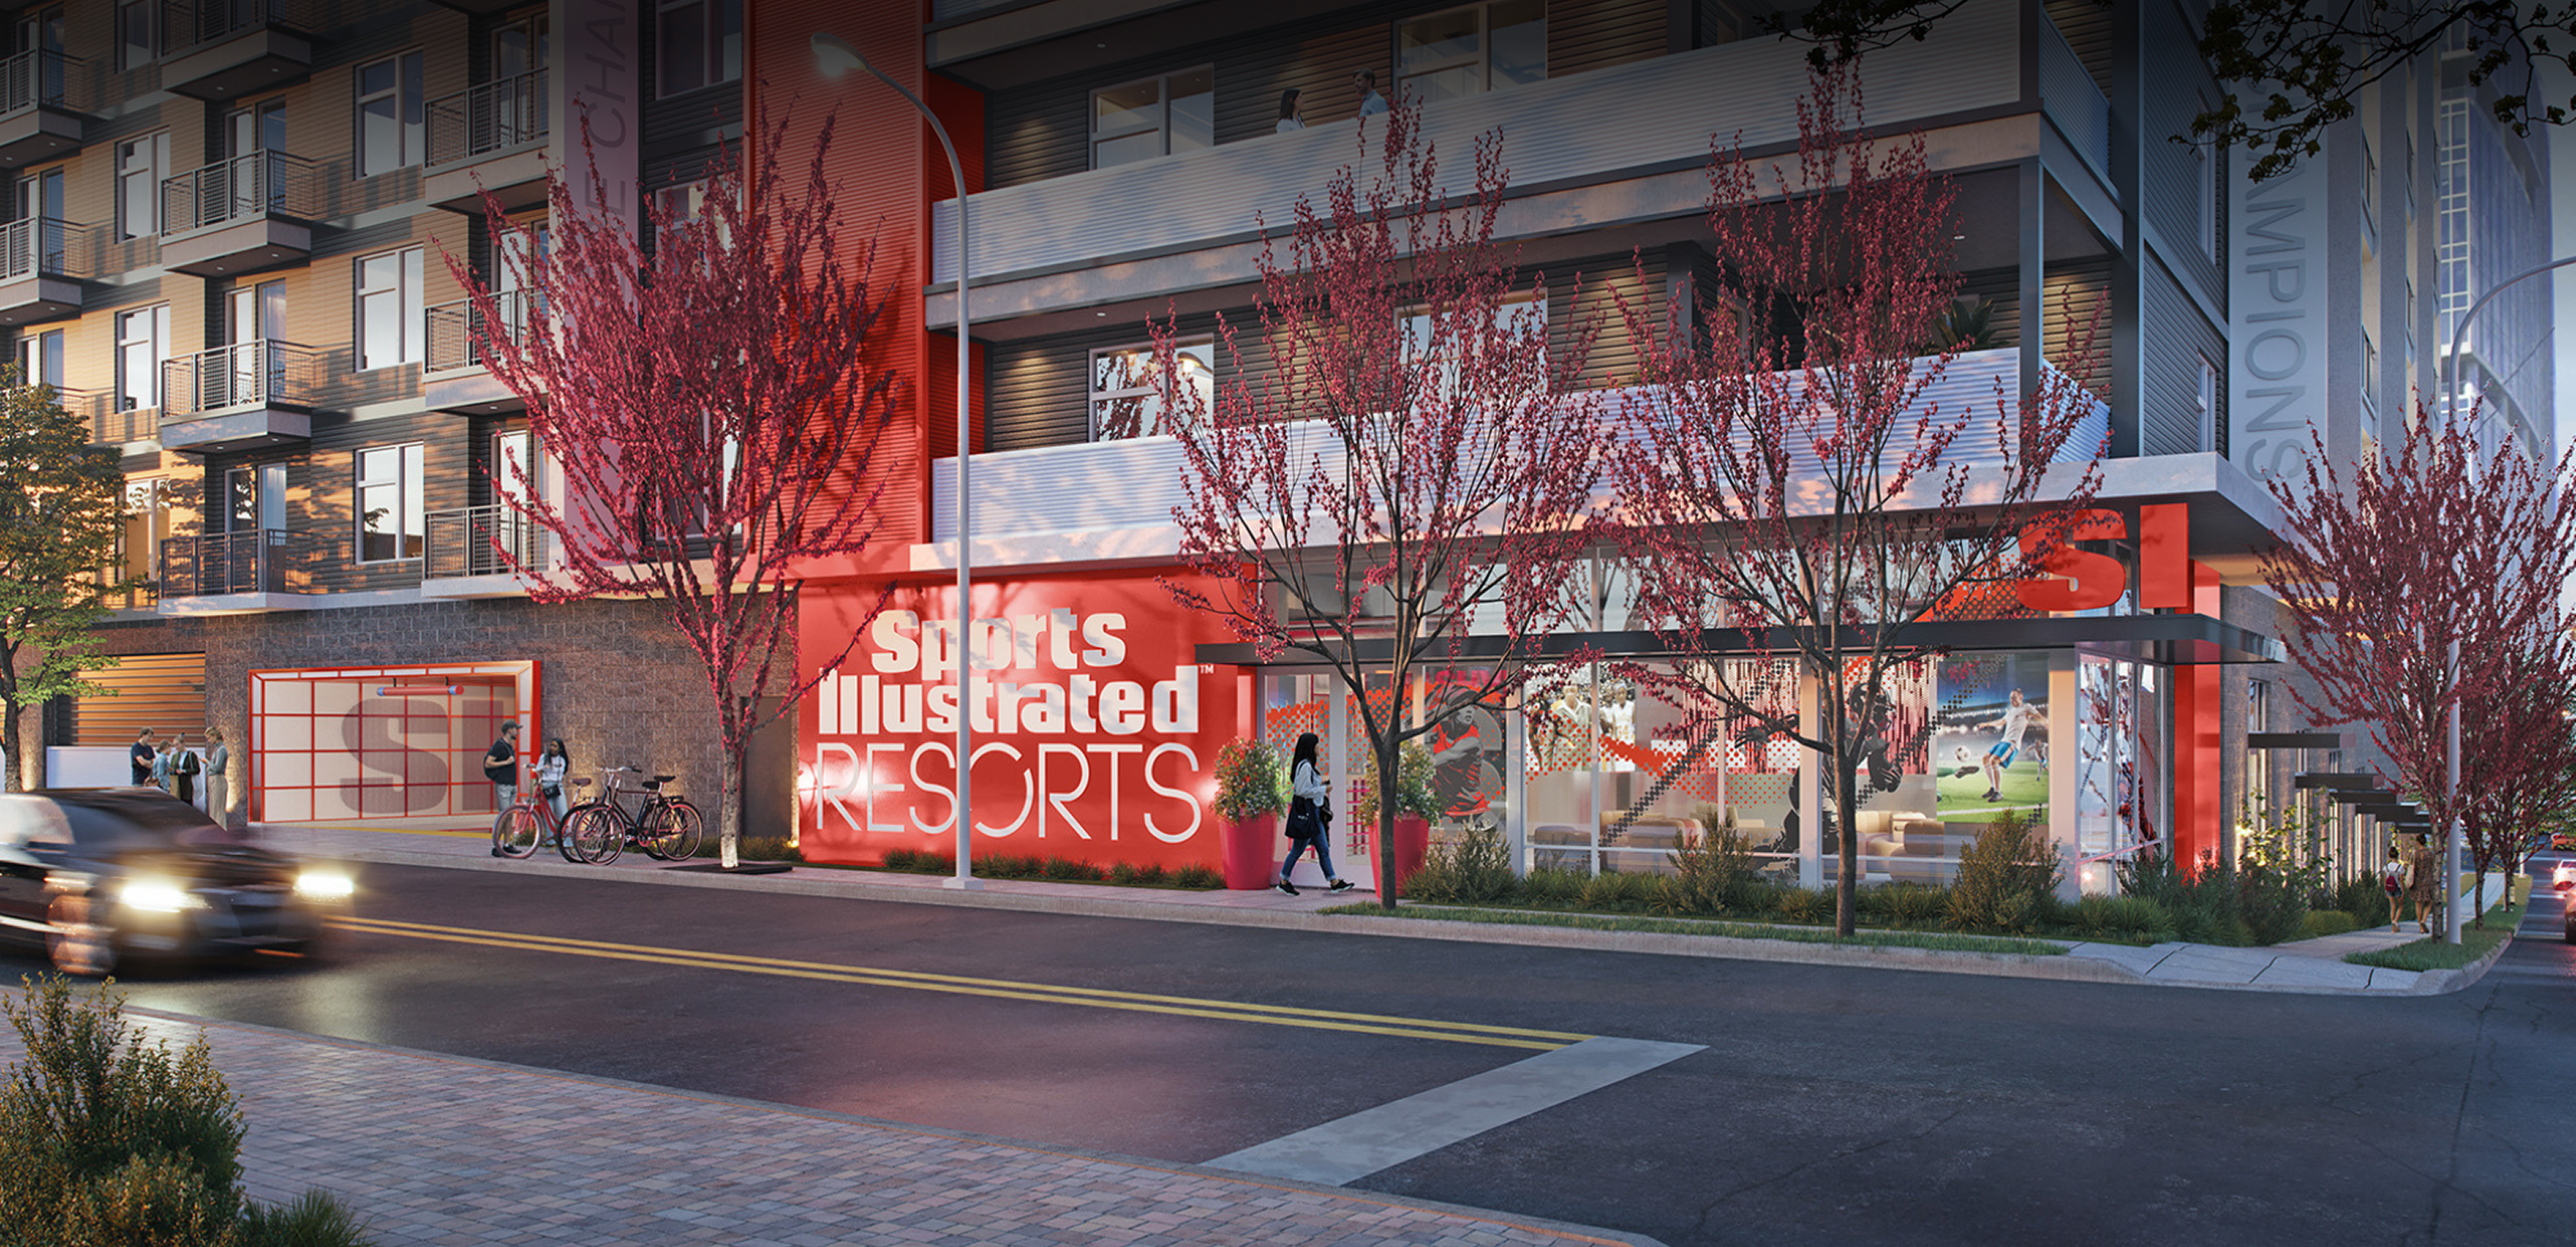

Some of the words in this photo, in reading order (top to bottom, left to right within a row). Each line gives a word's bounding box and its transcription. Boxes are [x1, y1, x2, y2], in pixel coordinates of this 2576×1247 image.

[585, 0, 626, 149] CHA
[2017, 503, 2189, 611] SI
[872, 608, 1126, 680] Sports
[818, 665, 1199, 735] Illustrated
[340, 698, 504, 814] SI
[817, 742, 1203, 843] RESORTS
